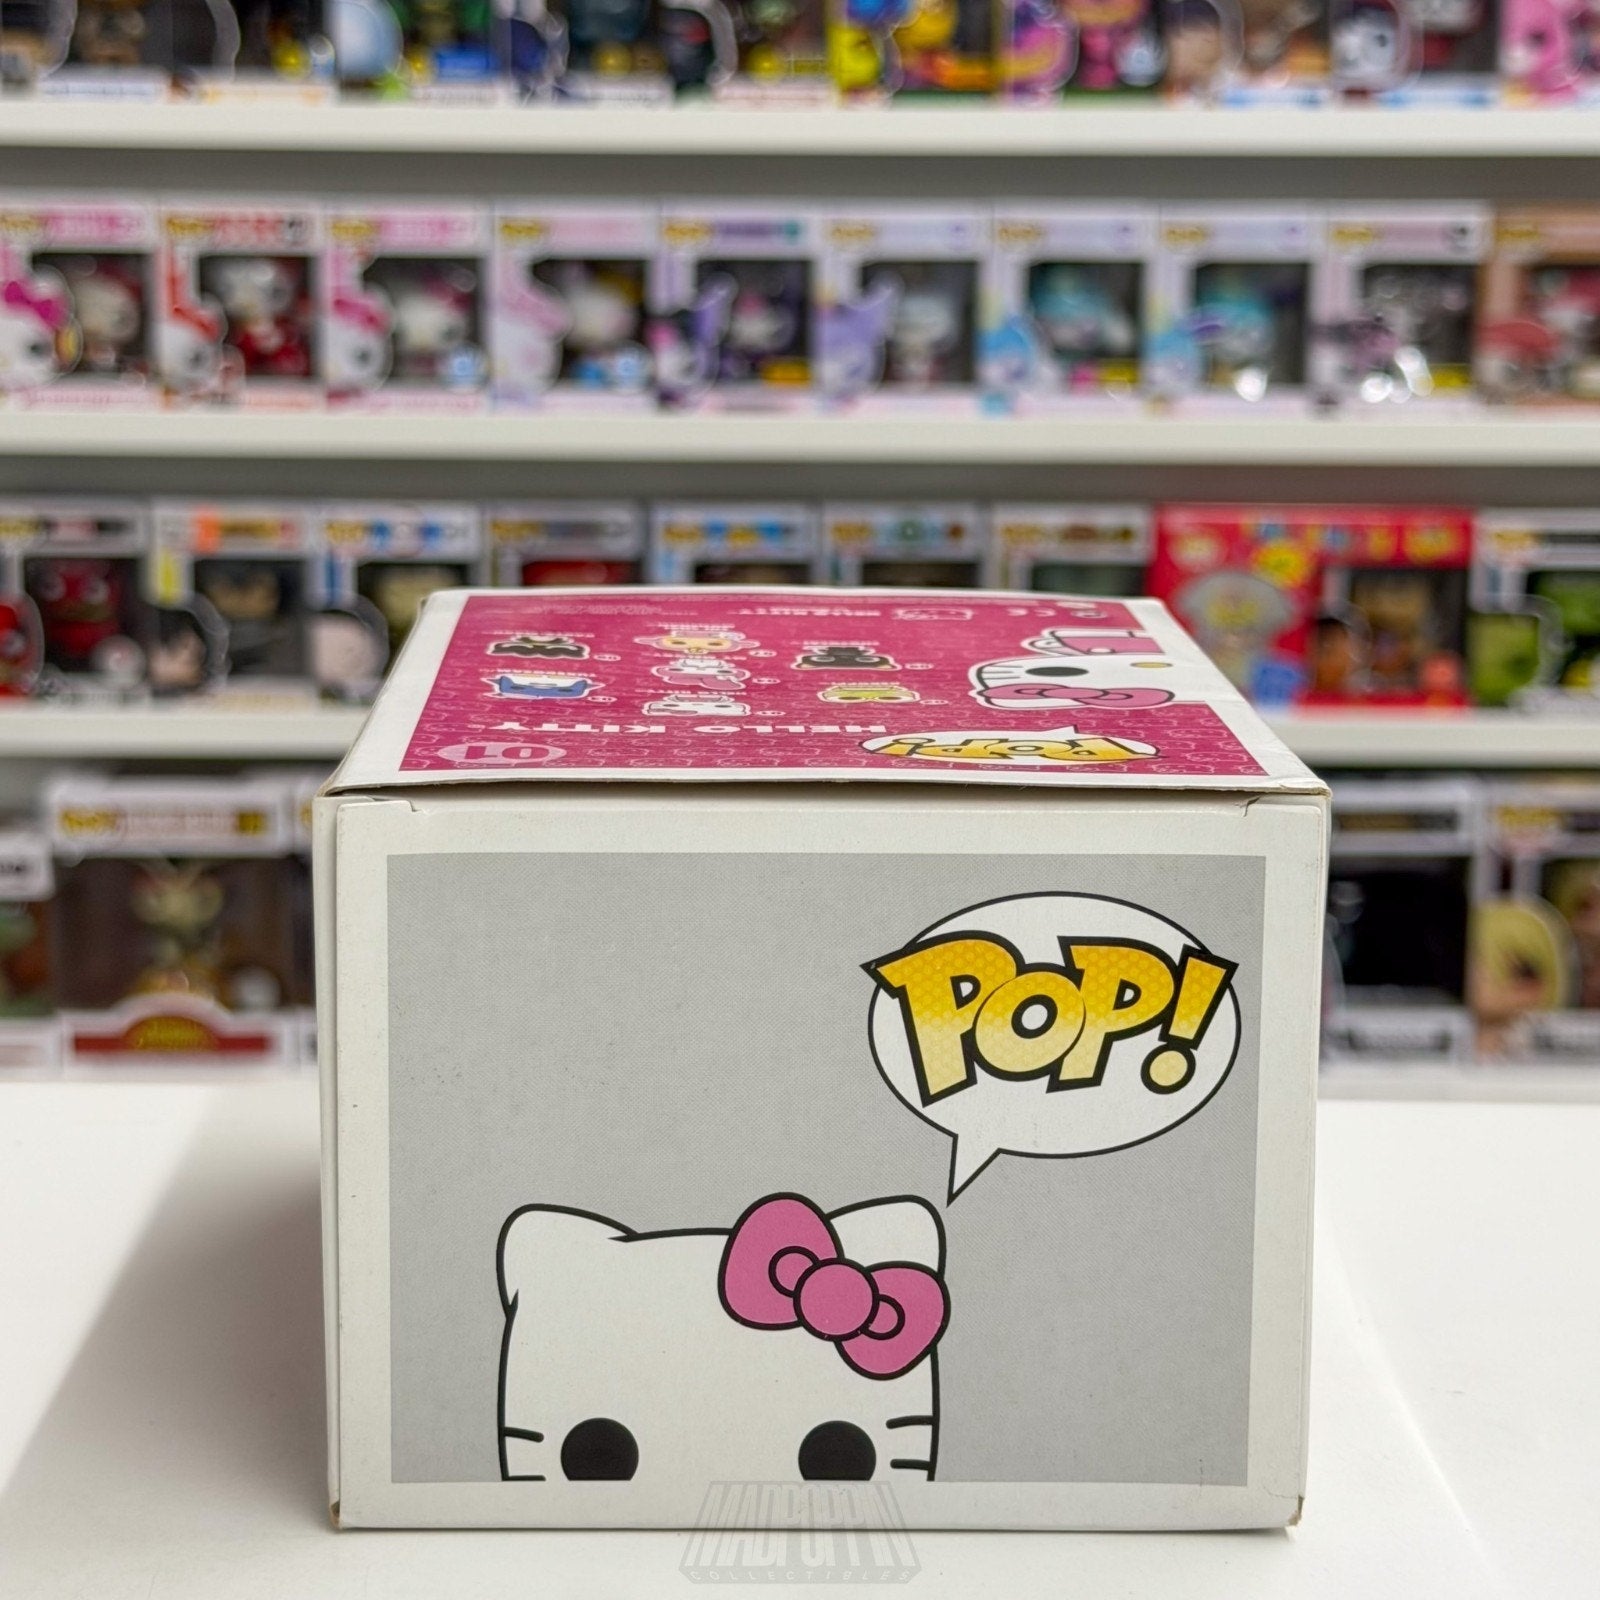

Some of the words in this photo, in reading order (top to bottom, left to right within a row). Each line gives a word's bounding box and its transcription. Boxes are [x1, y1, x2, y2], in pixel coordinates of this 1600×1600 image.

[488, 721, 666, 733] KITTY
[694, 725, 887, 733] HELLO
[464, 745, 550, 760] 01
[869, 737, 1169, 762] POP!
[859, 929, 1240, 1108] POP!
